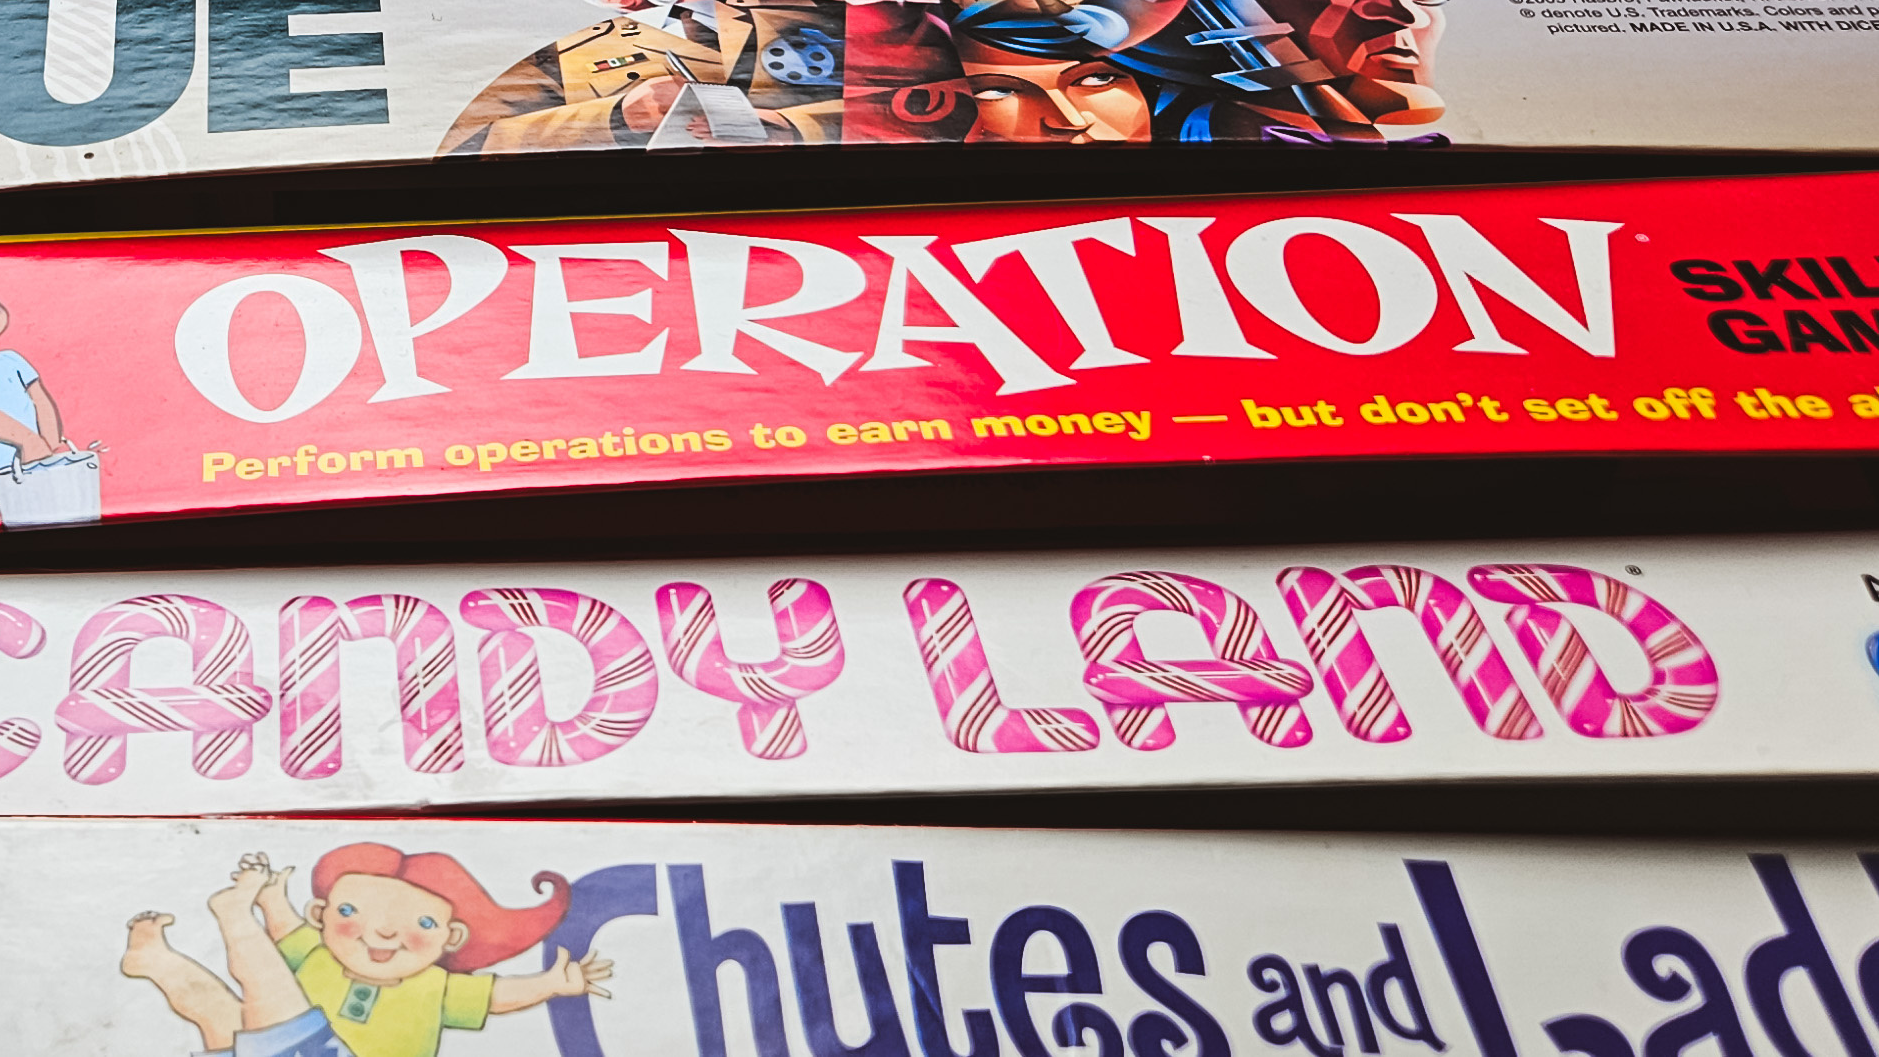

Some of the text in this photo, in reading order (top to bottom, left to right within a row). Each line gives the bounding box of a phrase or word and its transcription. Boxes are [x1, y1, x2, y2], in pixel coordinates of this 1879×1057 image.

[1540, 8, 1603, 19] denote
[1606, 7, 1646, 18] U.S.
[1647, 6, 1760, 18] Trademarks.
[1764, 5, 1824, 16] Colors
[1827, 4, 1865, 16] and
[1547, 23, 1627, 35] pictured.
[1629, 22, 1690, 33] MADE
[1692, 21, 1716, 32] IN
[1717, 20, 1777, 32] U.S.A.
[1778, 20, 1834, 31] WITH
[174, 213, 1625, 424] OPERATION
[1668, 256, 1879, 304] SKIL
[202, 443, 425, 482] Perform
[444, 426, 733, 473] operations
[751, 422, 807, 450] to
[826, 416, 952, 447] earn
[971, 406, 1153, 443] money
[1242, 398, 1344, 429] but
[1359, 391, 1510, 426] don't
[1523, 388, 1619, 423] set
[1632, 385, 1716, 421] off
[1732, 388, 1835, 420] the
[902, 563, 1720, 754] LAND
[541, 858, 1232, 1057] Chutes
[1246, 921, 1450, 1057] and
